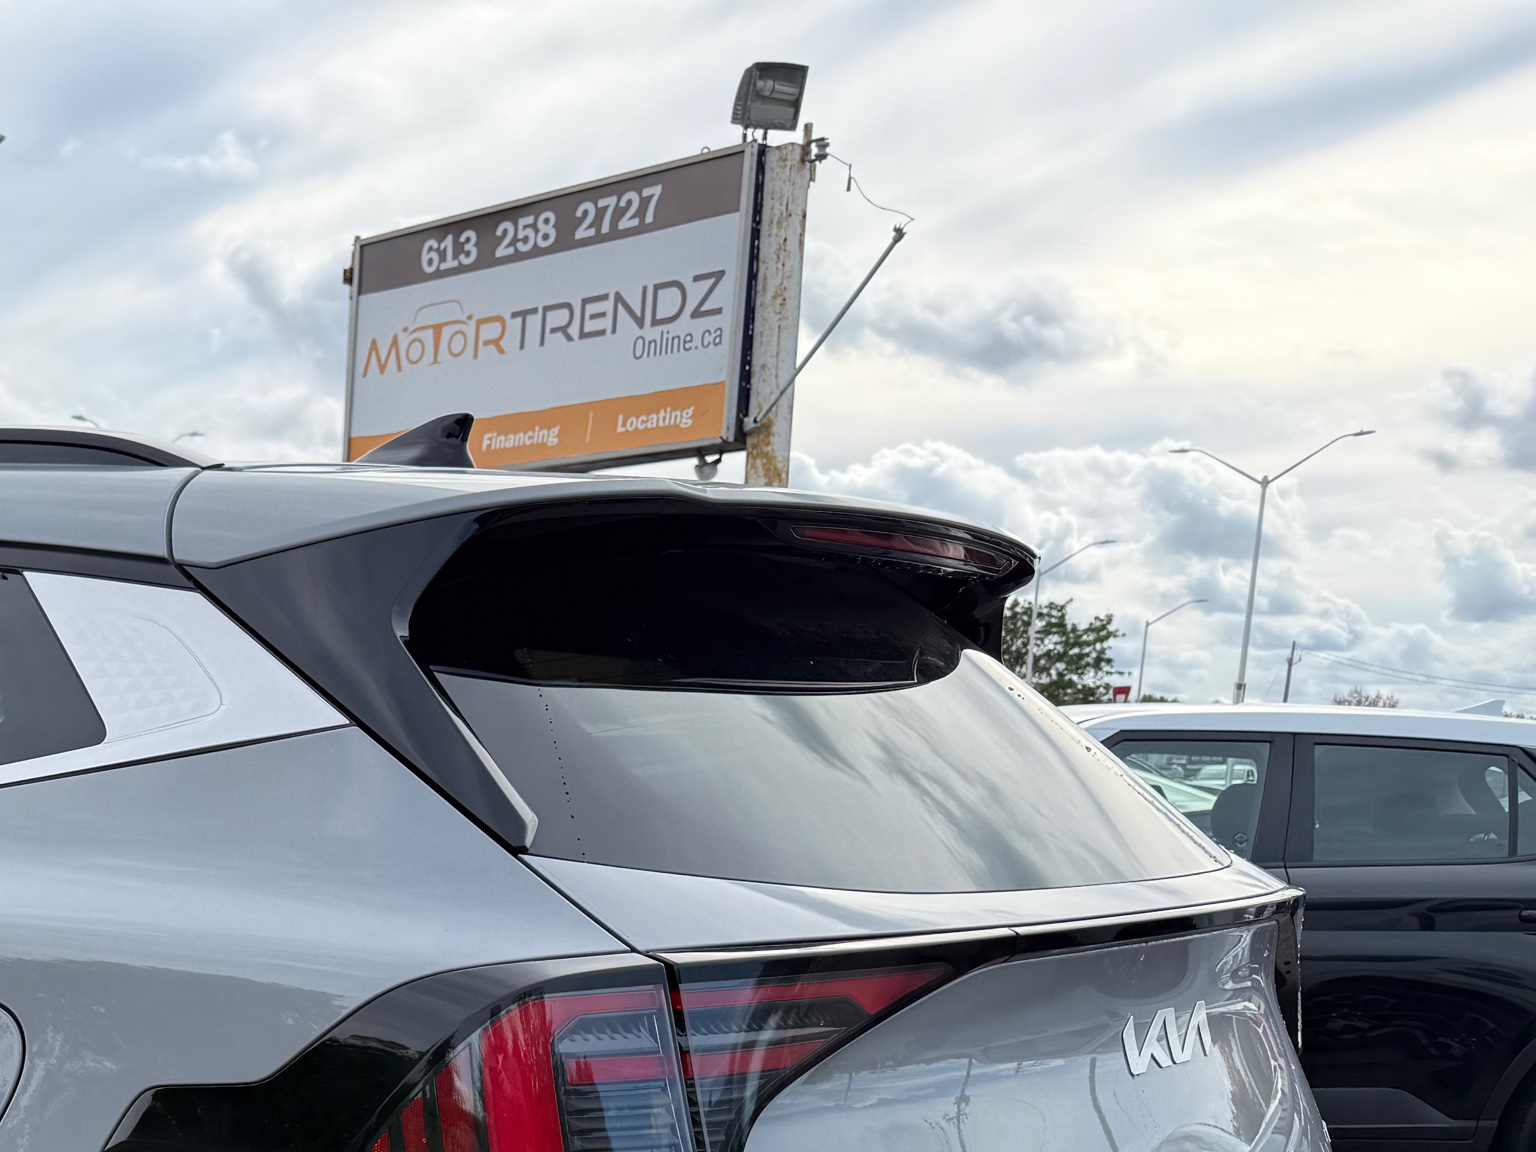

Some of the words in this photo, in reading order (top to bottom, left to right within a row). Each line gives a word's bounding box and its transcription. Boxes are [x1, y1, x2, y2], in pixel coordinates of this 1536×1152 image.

[420, 229, 478, 274] 613
[494, 211, 557, 258] 258
[574, 184, 663, 241] 2727
[632, 326, 724, 361] Online.ca
[481, 423, 561, 452] Financing
[616, 405, 695, 434] Locating
